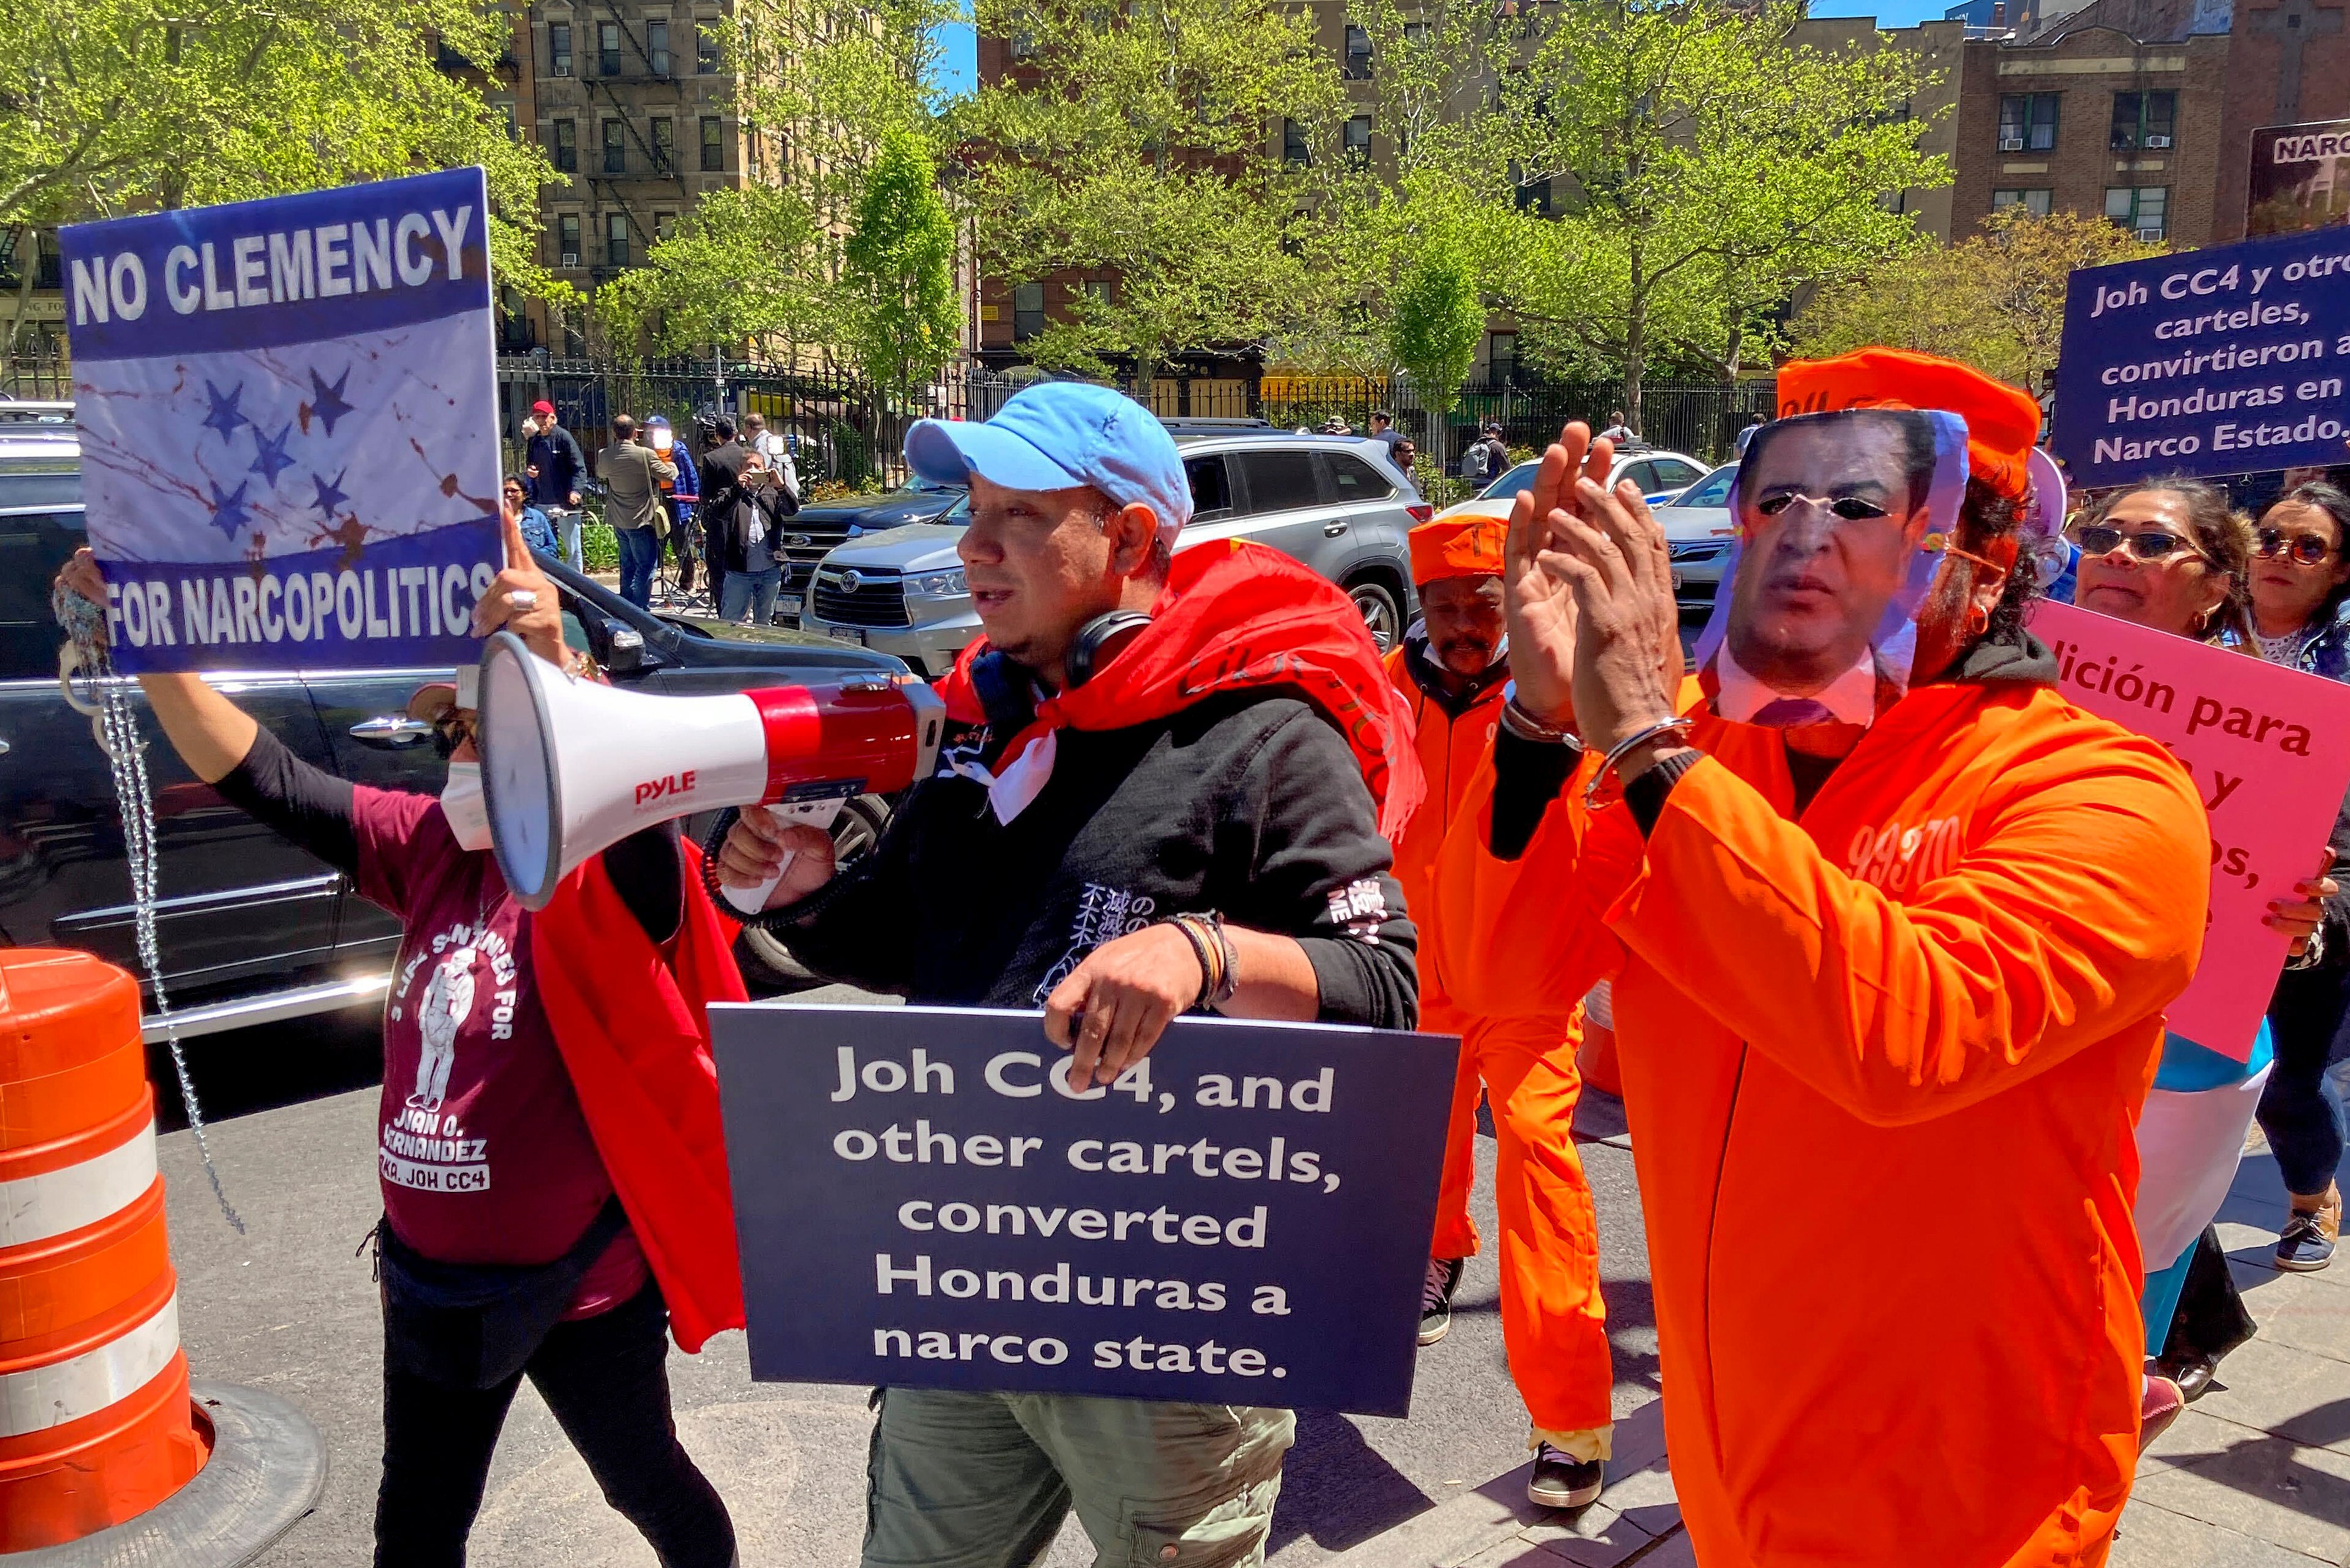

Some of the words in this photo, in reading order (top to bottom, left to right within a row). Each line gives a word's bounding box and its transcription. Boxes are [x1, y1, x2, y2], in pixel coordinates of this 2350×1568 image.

[71, 252, 147, 325] NO
[165, 205, 472, 315] CLEMENCY
[2090, 281, 2147, 318] Joh
[2160, 264, 2239, 299] CC4
[2250, 267, 2272, 294] y
[2155, 300, 2310, 340] carteles,
[2101, 343, 2323, 385] convirtieron
[2108, 385, 2283, 423] Honduras
[2296, 379, 2341, 401] en
[2094, 436, 2200, 464] Narco
[2213, 415, 2350, 451] Estado.
[107, 581, 177, 647] FOR
[2186, 695, 2311, 758] para
[635, 771, 696, 805] PYLE
[491, 990, 517, 1040] FOR
[831, 1047, 955, 1102] Joh
[984, 1051, 1176, 1114] CC4,
[1196, 1067, 1334, 1112] and
[443, 1115, 464, 1137] O.
[407, 1169, 438, 1188] JOH
[446, 1171, 485, 1189] CC4
[833, 1119, 1043, 1167] other
[1068, 1136, 1340, 1193] cartels,
[898, 1200, 1267, 1247] converted
[876, 1253, 1226, 1311] Honduras
[1251, 1285, 1291, 1315] a
[874, 1329, 1068, 1365] narco
[1094, 1335, 1287, 1378] state.
